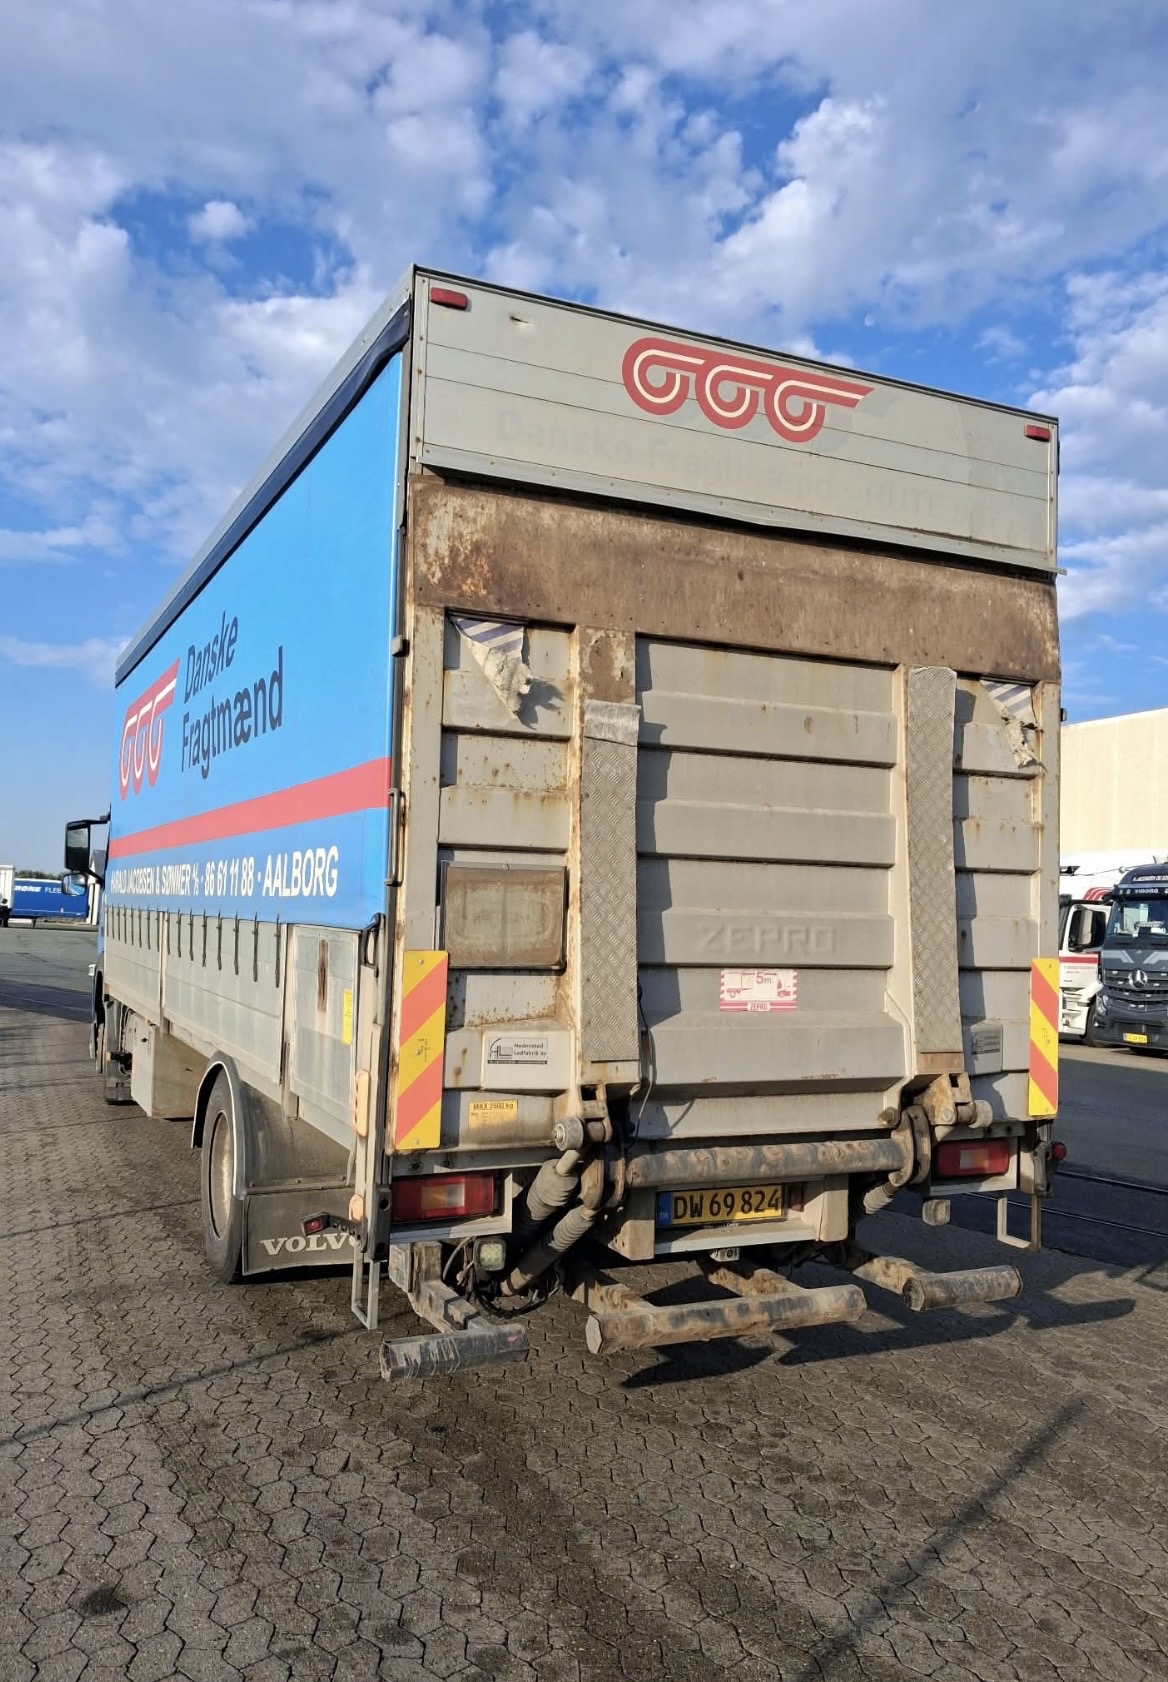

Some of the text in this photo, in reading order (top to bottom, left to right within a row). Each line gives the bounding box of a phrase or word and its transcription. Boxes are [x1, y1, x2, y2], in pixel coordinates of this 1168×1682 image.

[184, 610, 238, 704] Danske
[181, 645, 283, 780] Fragtmænd
[204, 861, 215, 897] 86
[216, 859, 228, 897] 61
[230, 858, 239, 897] 11
[240, 856, 255, 897] 88
[262, 845, 339, 898] AALBORG
[14, 885, 62, 894] RONE FLEE
[697, 923, 838, 955] ZEPRO
[750, 1002, 768, 1011] ZEPRO
[473, 1102, 488, 1110] MAX
[673, 1188, 781, 1220] DW 69 824
